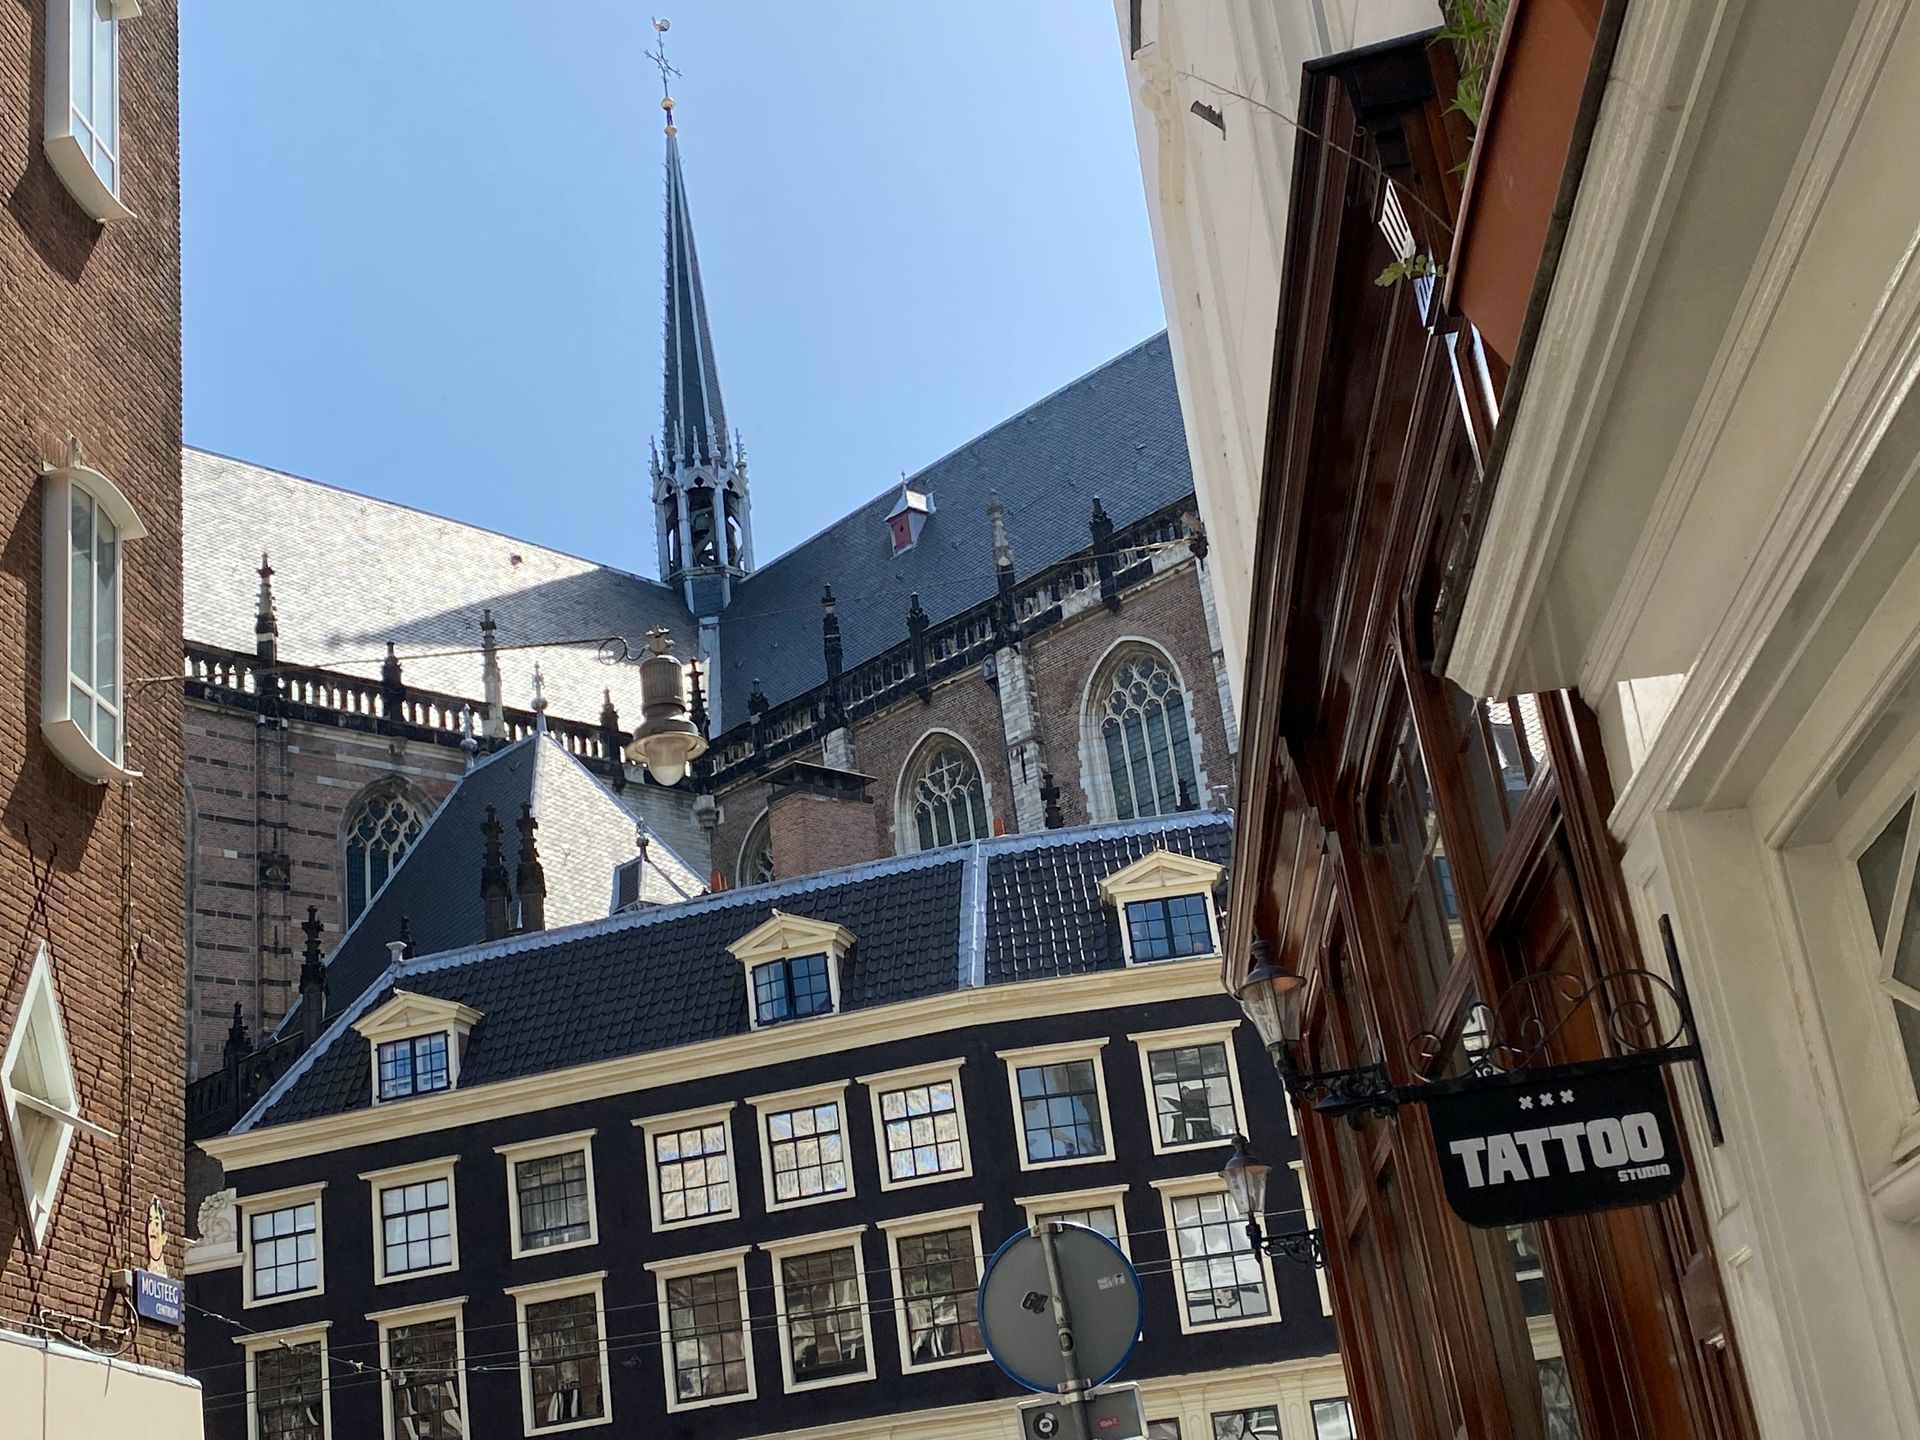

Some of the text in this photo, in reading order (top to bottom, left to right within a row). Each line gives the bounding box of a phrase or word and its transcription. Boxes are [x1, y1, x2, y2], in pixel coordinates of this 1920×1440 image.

[1449, 1112, 1665, 1188] TATTOO
[1618, 1163, 1671, 1183] STUDIO
[141, 1277, 179, 1304] MOLSTEEG
